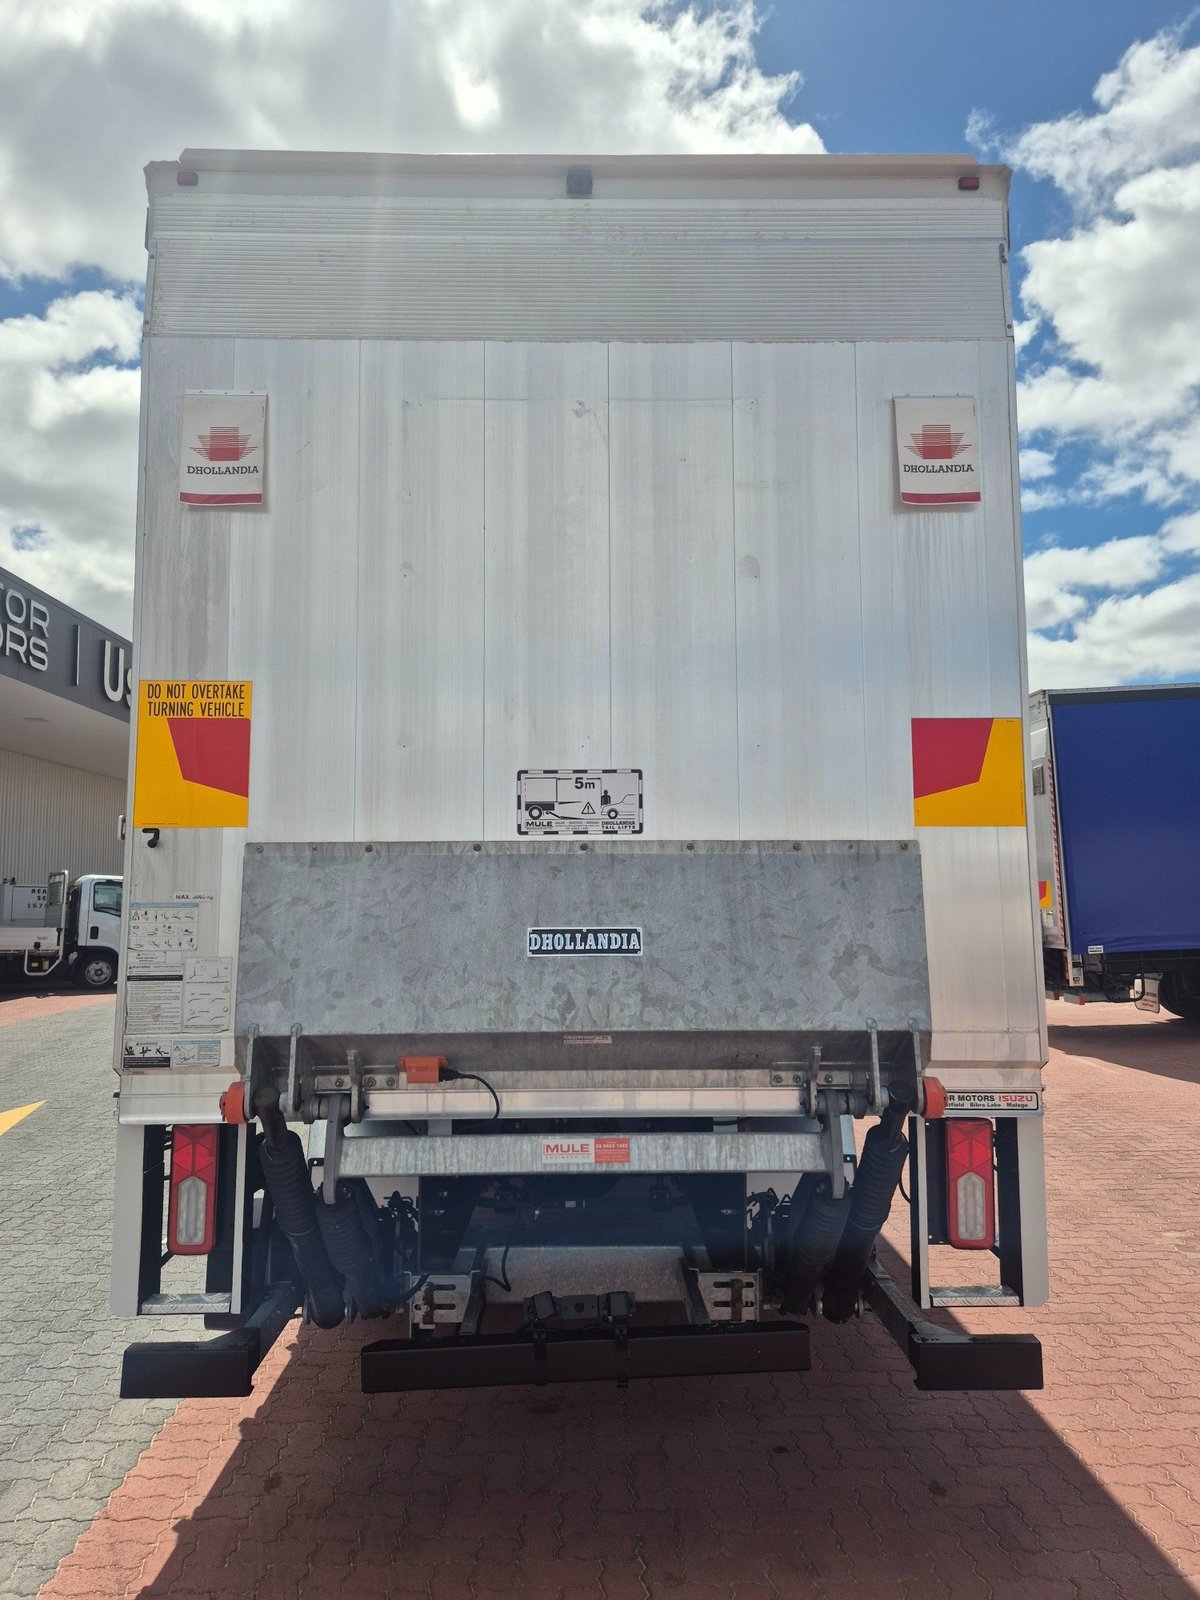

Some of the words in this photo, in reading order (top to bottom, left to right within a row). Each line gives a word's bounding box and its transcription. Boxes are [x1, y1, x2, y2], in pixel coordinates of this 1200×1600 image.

[187, 465, 259, 475] DHOLLANDIA
[903, 464, 974, 473] DHOLLANDIA
[0, 583, 50, 638] OR
[0, 623, 49, 672] RS
[103, 639, 132, 709] U
[147, 683, 161, 699] DO
[167, 684, 186, 699] NOT
[191, 684, 245, 699] OVERTAKE
[148, 702, 194, 716] TURNING
[200, 702, 245, 717] VEHICLE
[574, 777, 595, 790] 5m
[529, 933, 640, 950] DHOLLANDIA
[546, 1143, 590, 1153] MULE
